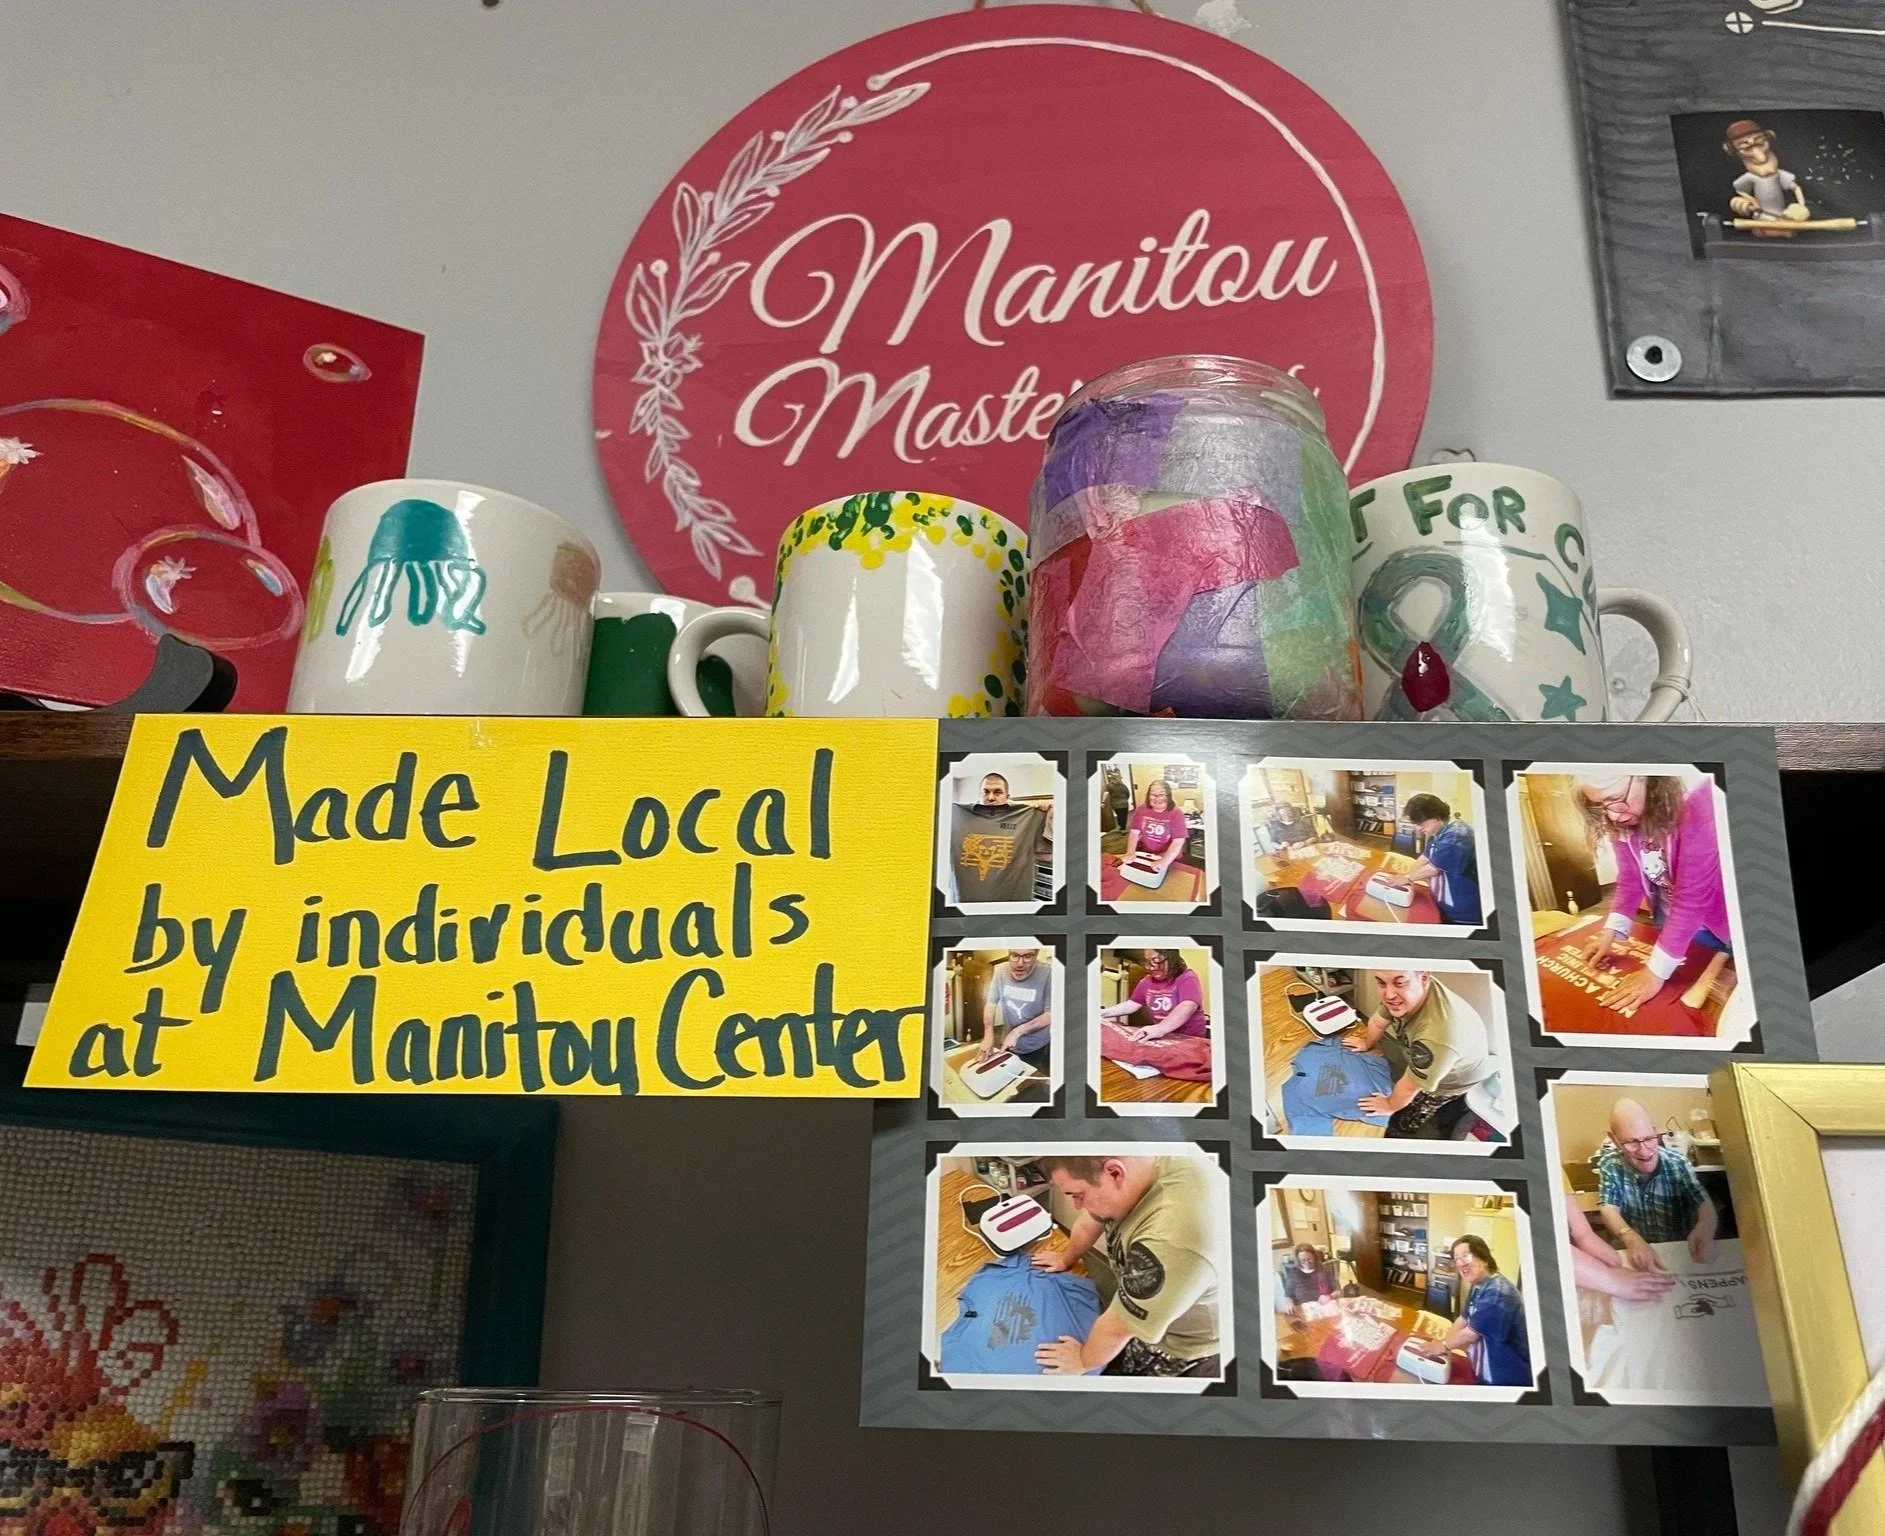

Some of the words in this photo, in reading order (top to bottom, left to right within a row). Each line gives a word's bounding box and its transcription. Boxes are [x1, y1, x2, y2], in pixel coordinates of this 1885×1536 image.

[748, 207, 1338, 353] Manitou
[733, 357, 1083, 466] Maste
[1403, 474, 1526, 536] FOR
[145, 727, 480, 865] Made
[532, 749, 833, 868] Local
[1145, 823, 1165, 836] 50
[124, 883, 246, 1013] by
[296, 863, 811, 969] individuals
[68, 988, 192, 1078] at
[253, 971, 640, 1095] Manitou
[656, 963, 926, 1084] Center
[1150, 996, 1171, 1011] 50
